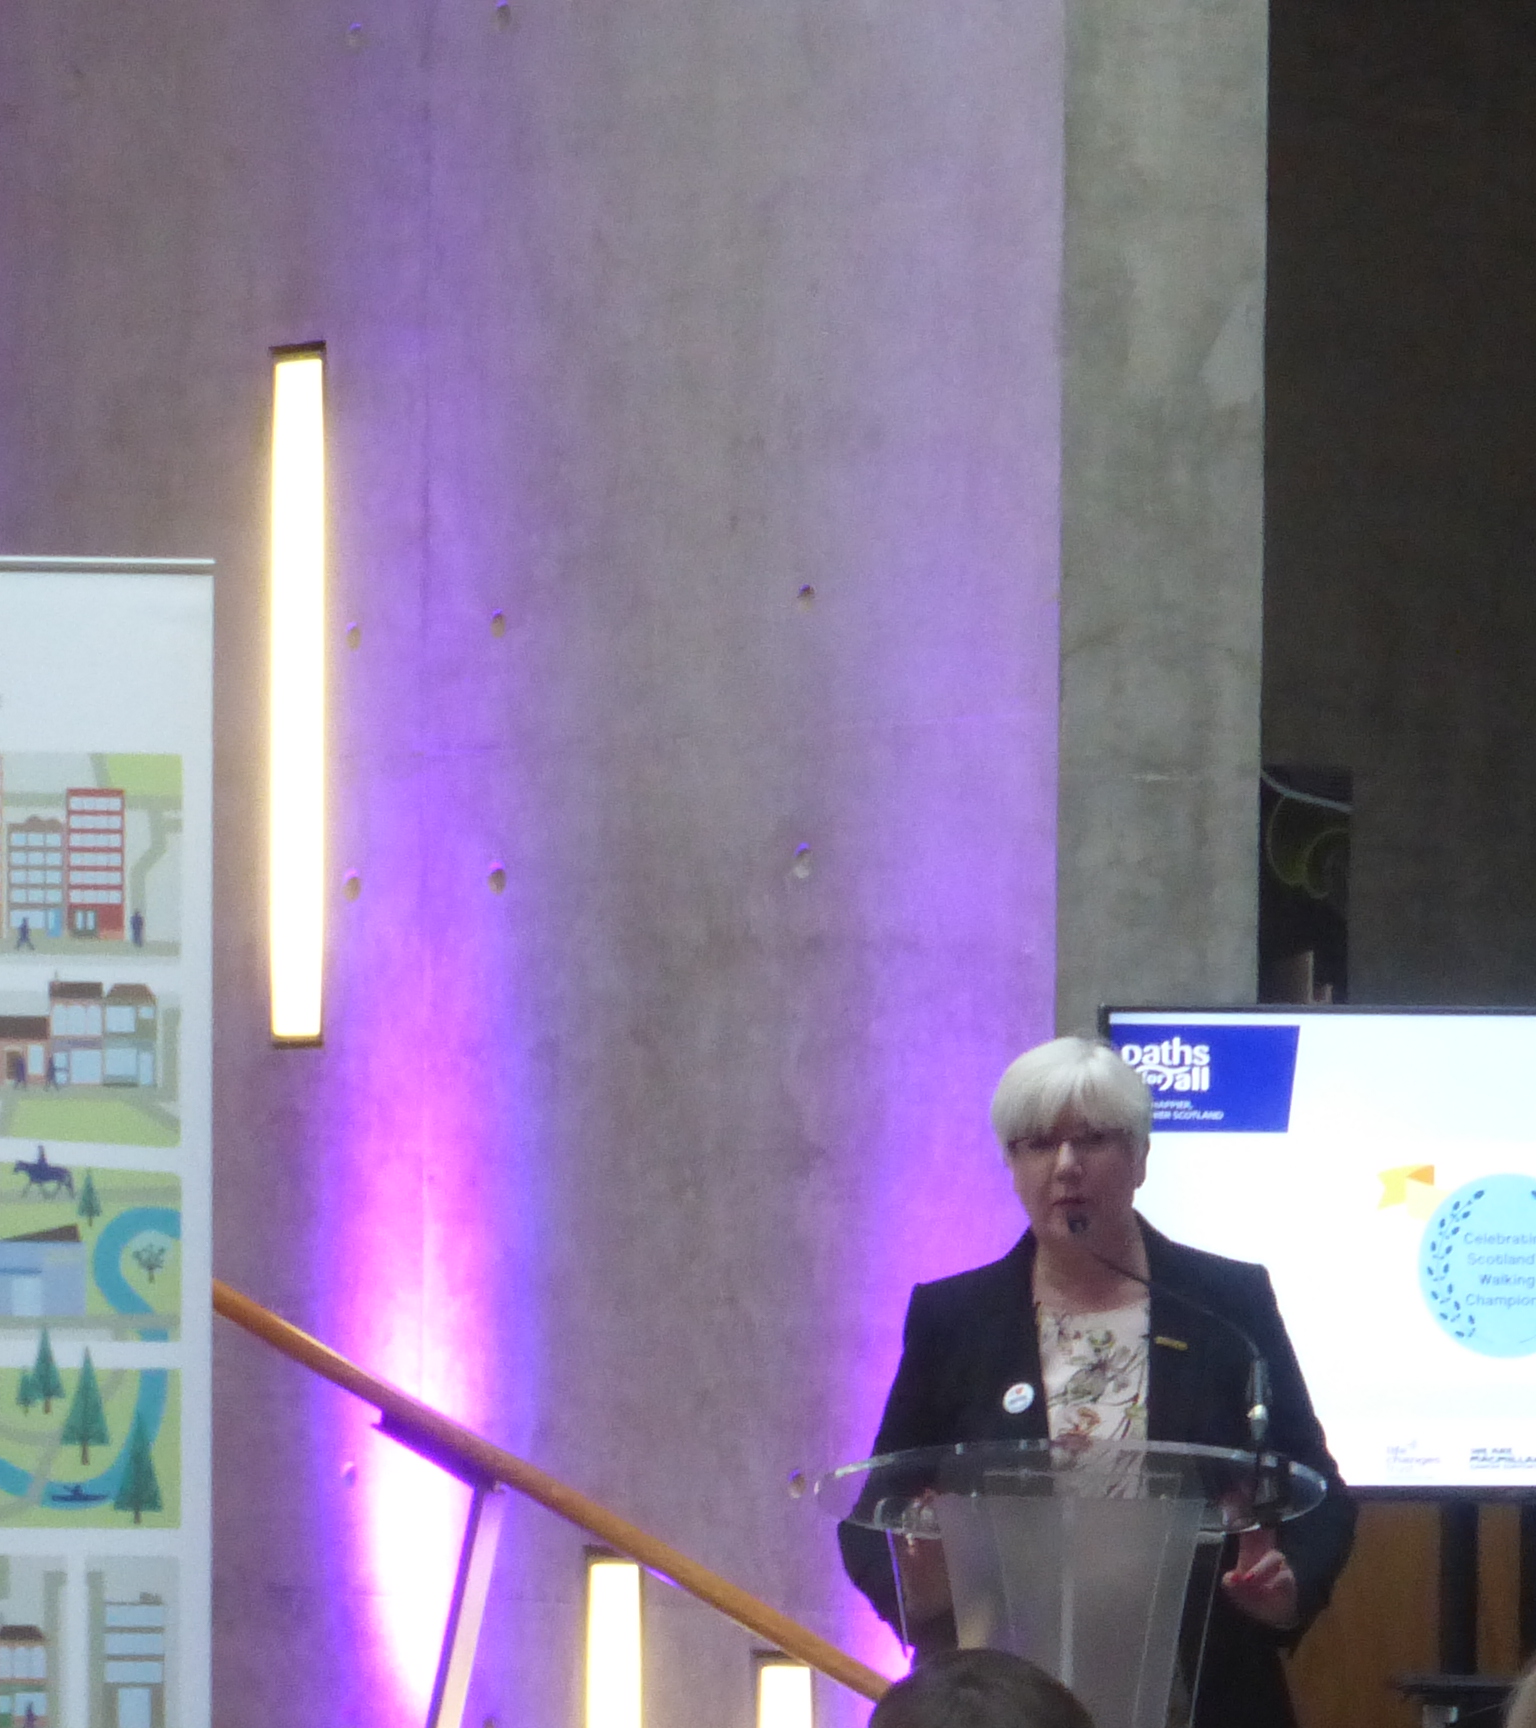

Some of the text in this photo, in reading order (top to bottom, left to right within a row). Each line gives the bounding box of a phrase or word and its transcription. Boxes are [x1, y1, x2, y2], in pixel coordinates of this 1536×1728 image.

[1173, 1065, 1211, 1092] all
[1172, 1110, 1225, 1121] SCOTLAND
[1479, 1273, 1536, 1290] Walking
[1386, 1455, 1441, 1466] changes
